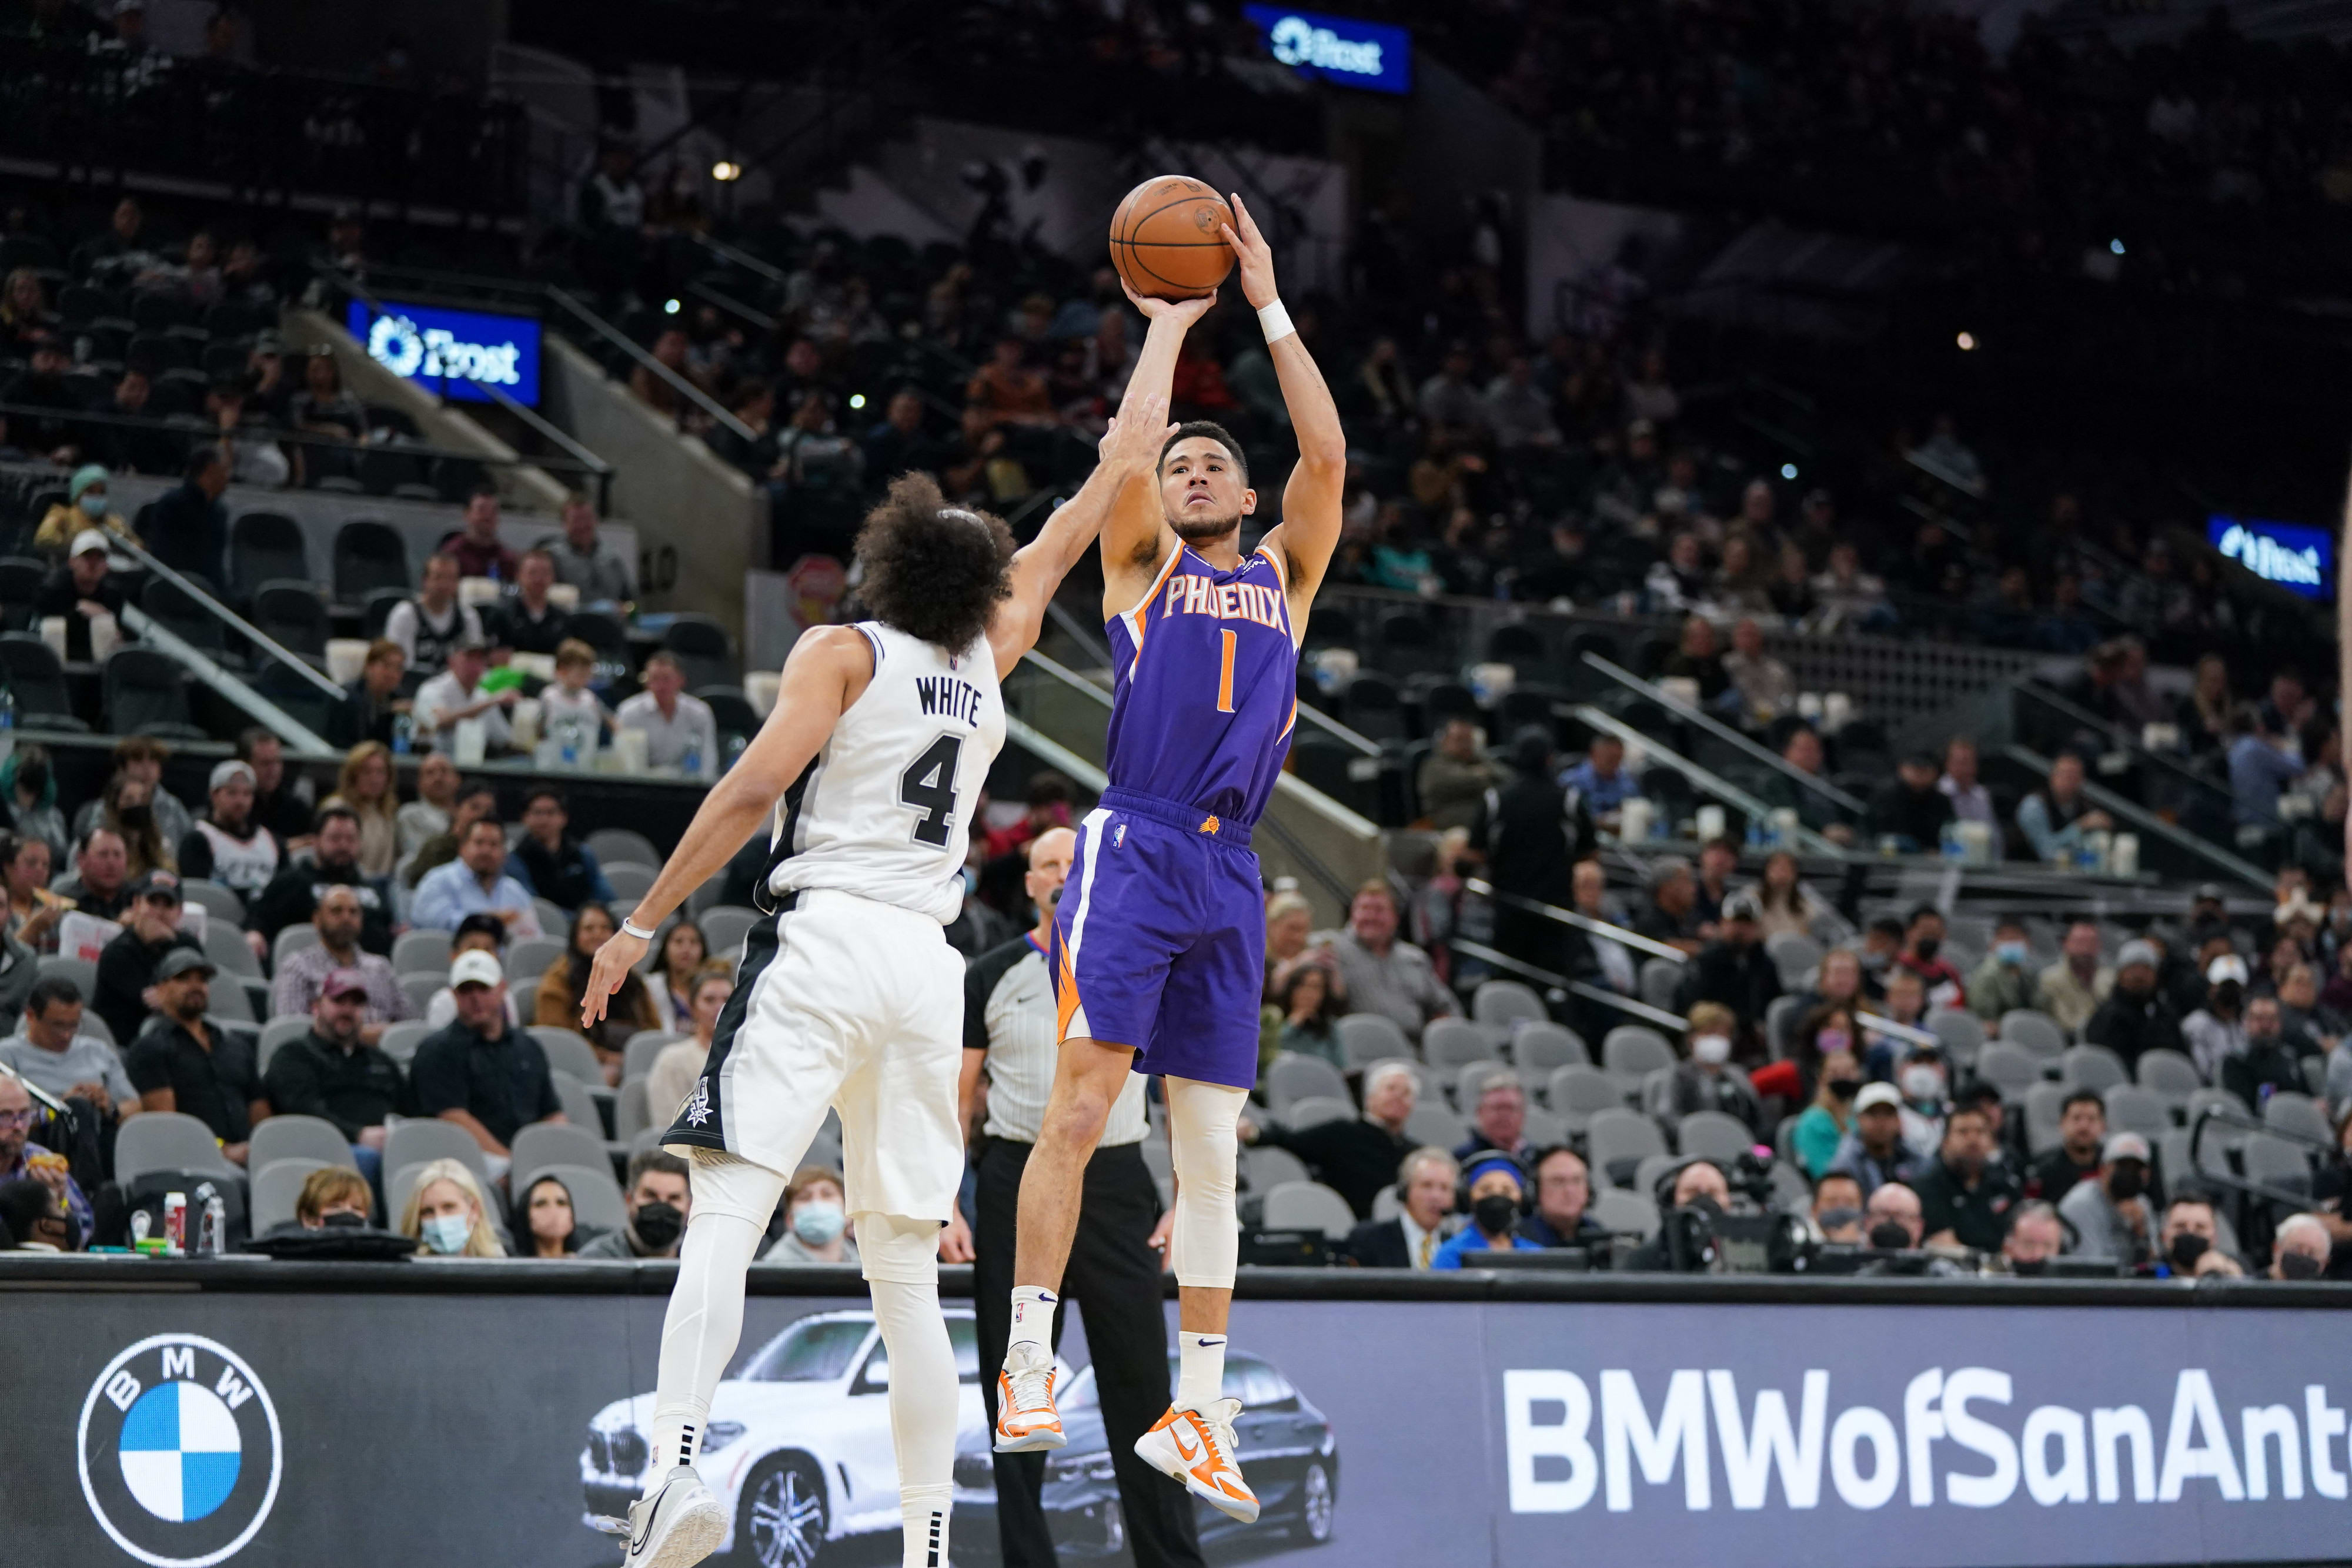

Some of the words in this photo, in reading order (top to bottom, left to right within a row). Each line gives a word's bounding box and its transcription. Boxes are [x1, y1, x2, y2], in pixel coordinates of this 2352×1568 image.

[422, 327, 520, 385] Frost
[1162, 574, 1288, 637] PHOENIX
[916, 676, 983, 729] WHITE
[1217, 628, 1237, 713] 1
[897, 729, 967, 853] 4
[105, 1347, 254, 1412] BMW
[1503, 1366, 2352, 1513] BMWofSanAnt
